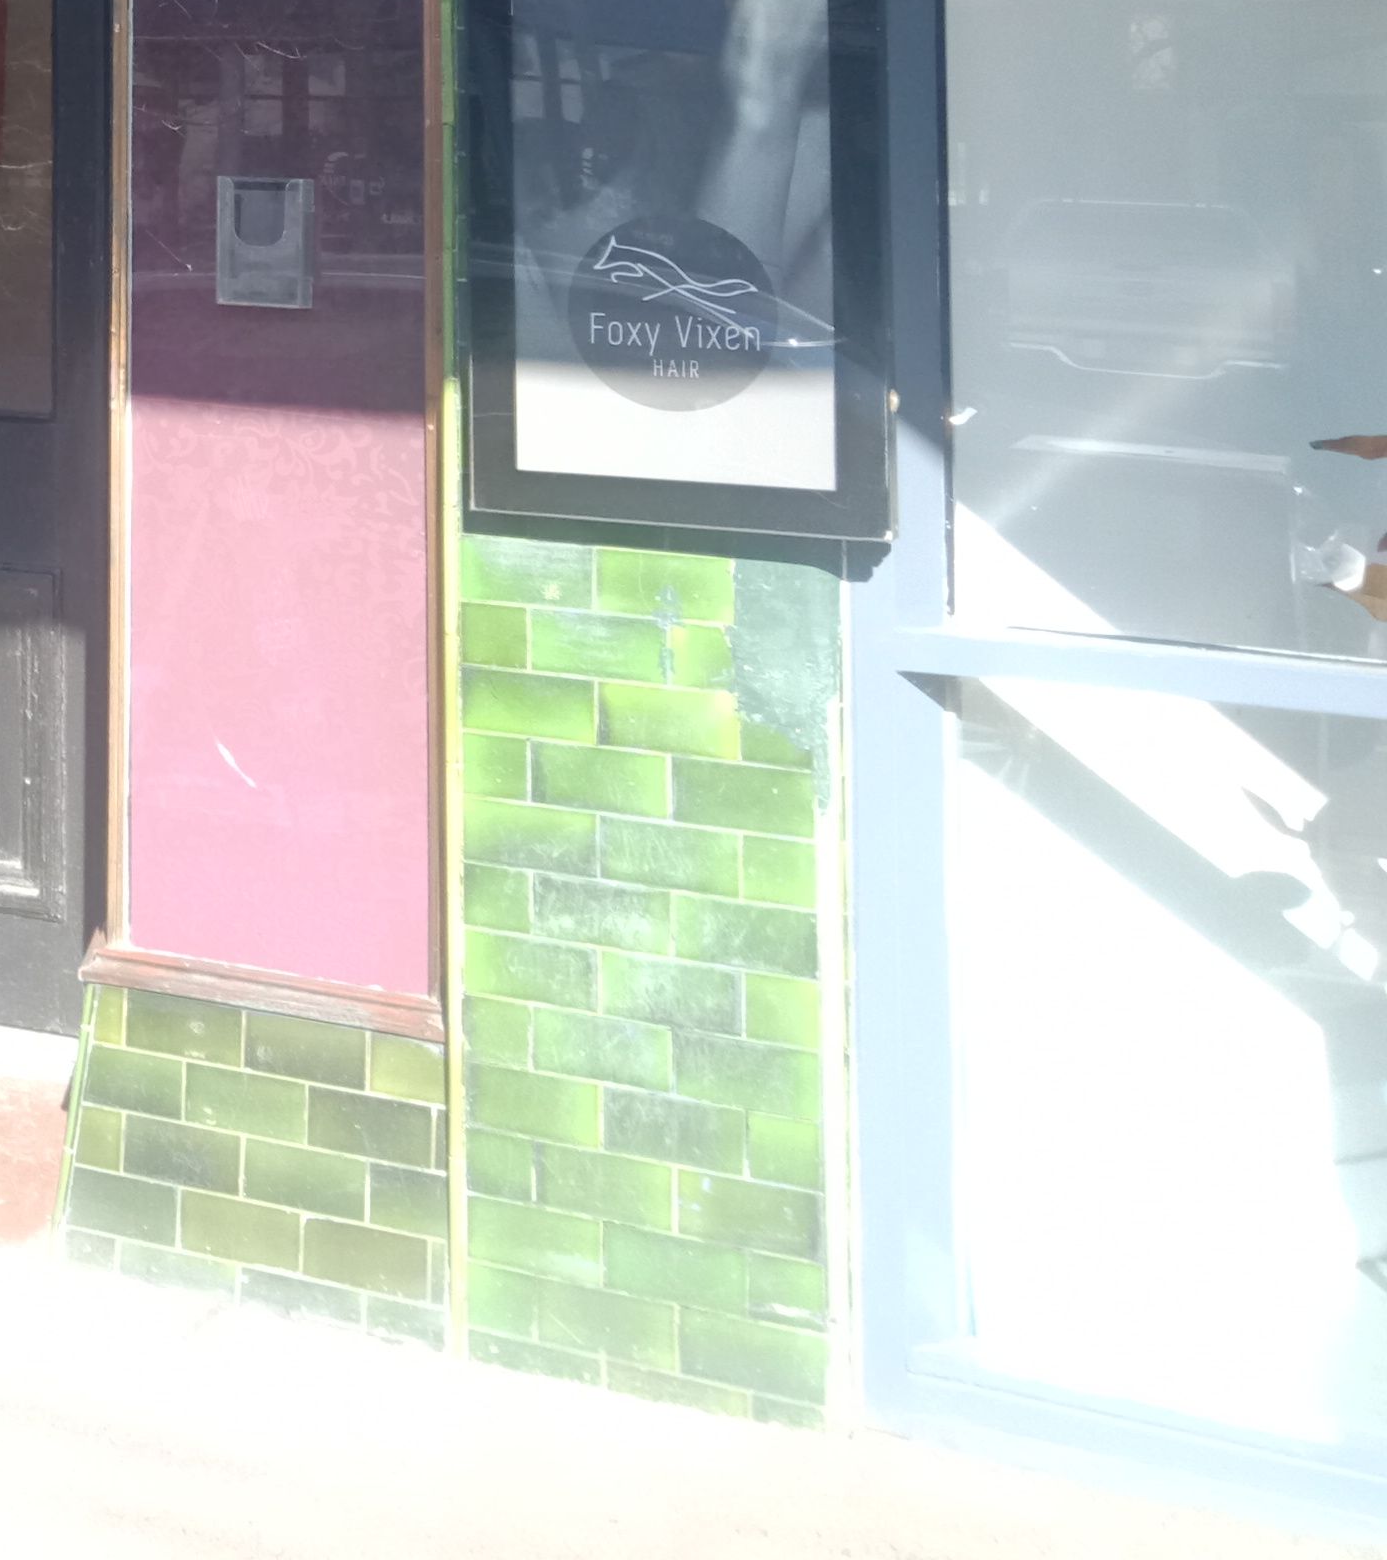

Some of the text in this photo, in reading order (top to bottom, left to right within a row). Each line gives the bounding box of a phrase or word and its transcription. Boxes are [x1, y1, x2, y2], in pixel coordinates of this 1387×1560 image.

[589, 312, 761, 356] Foxy Vixen
[653, 359, 700, 379] HAIR
